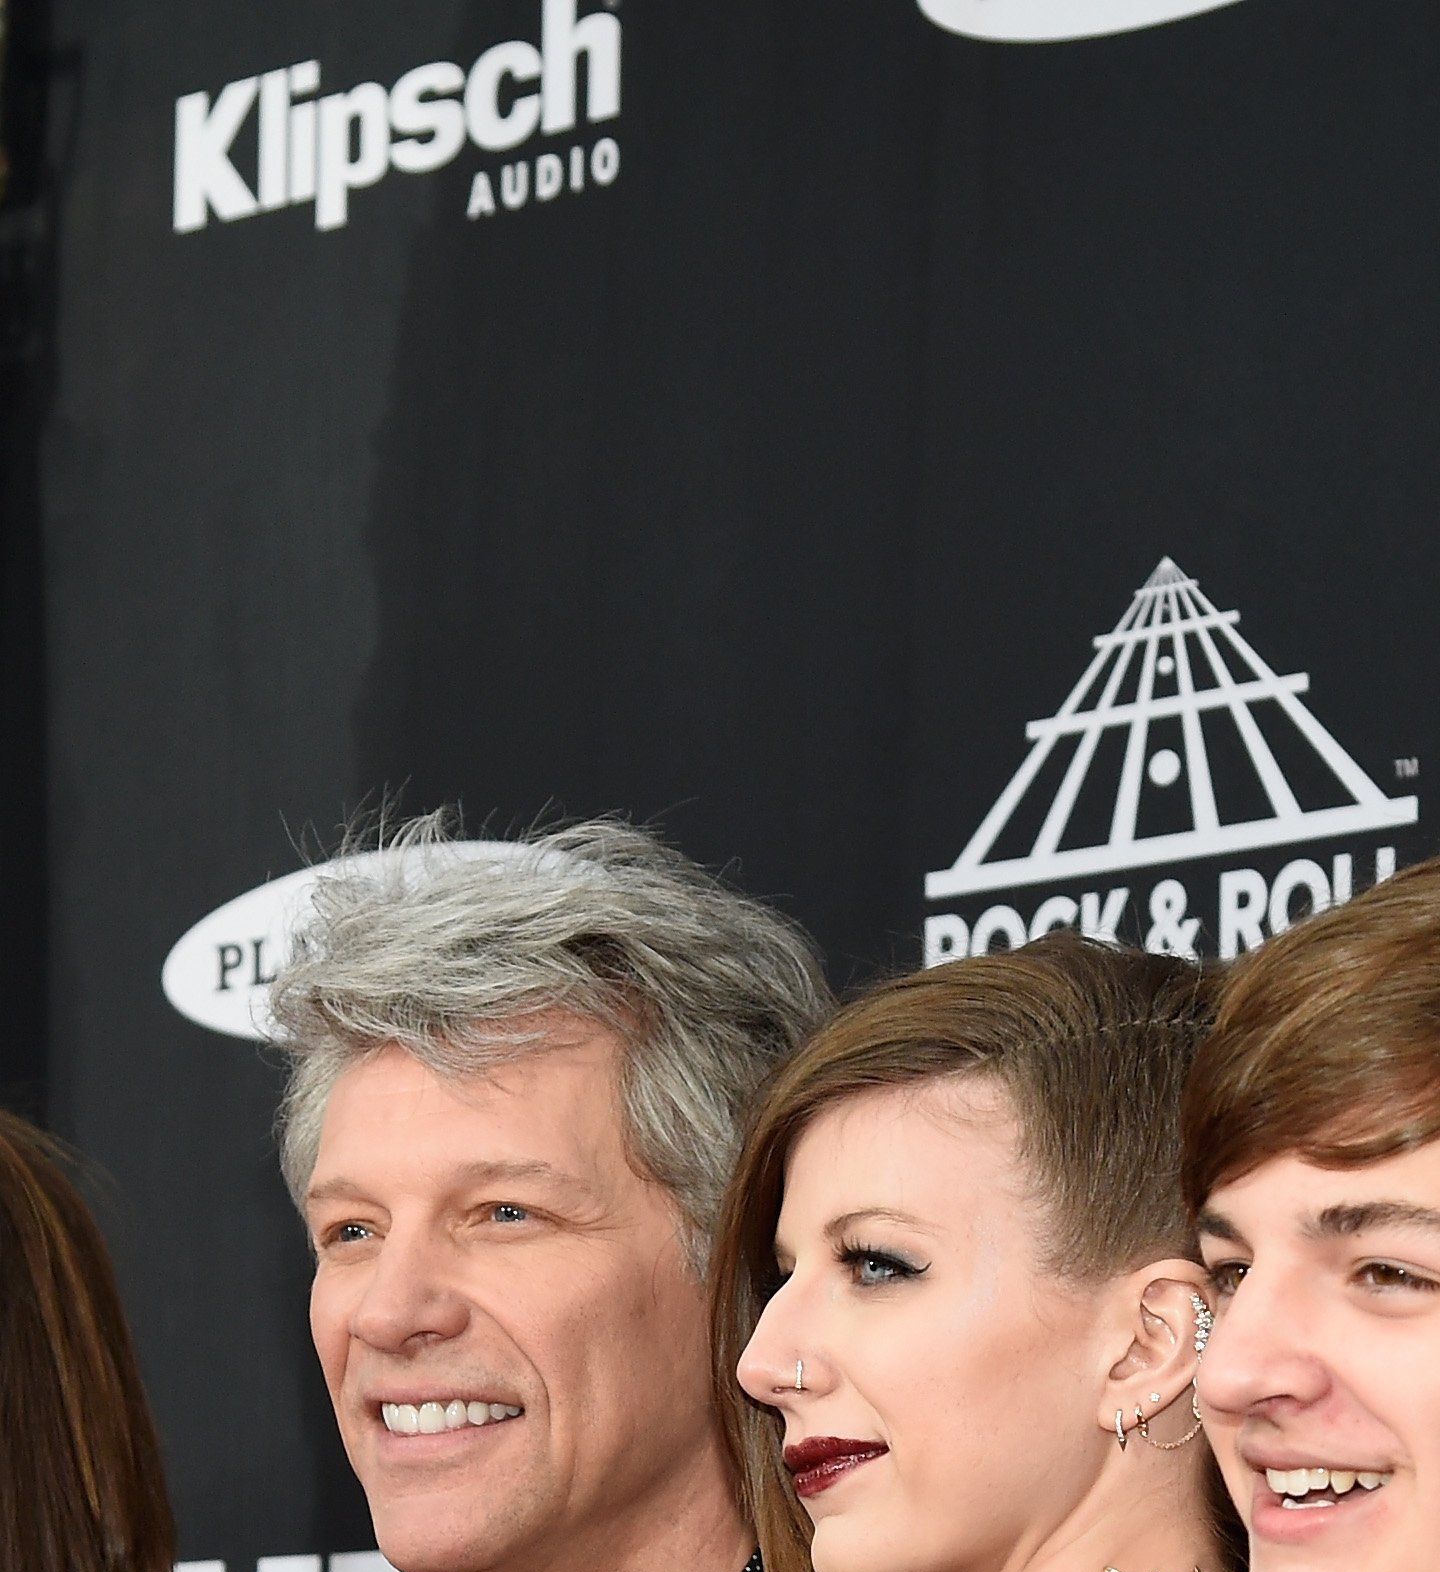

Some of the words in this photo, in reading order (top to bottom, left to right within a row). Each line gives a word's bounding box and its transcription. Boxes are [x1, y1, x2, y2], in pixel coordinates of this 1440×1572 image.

[173, 0, 622, 233] Klipsch
[466, 138, 621, 220] AUDIO
[1145, 878, 1203, 964] &
